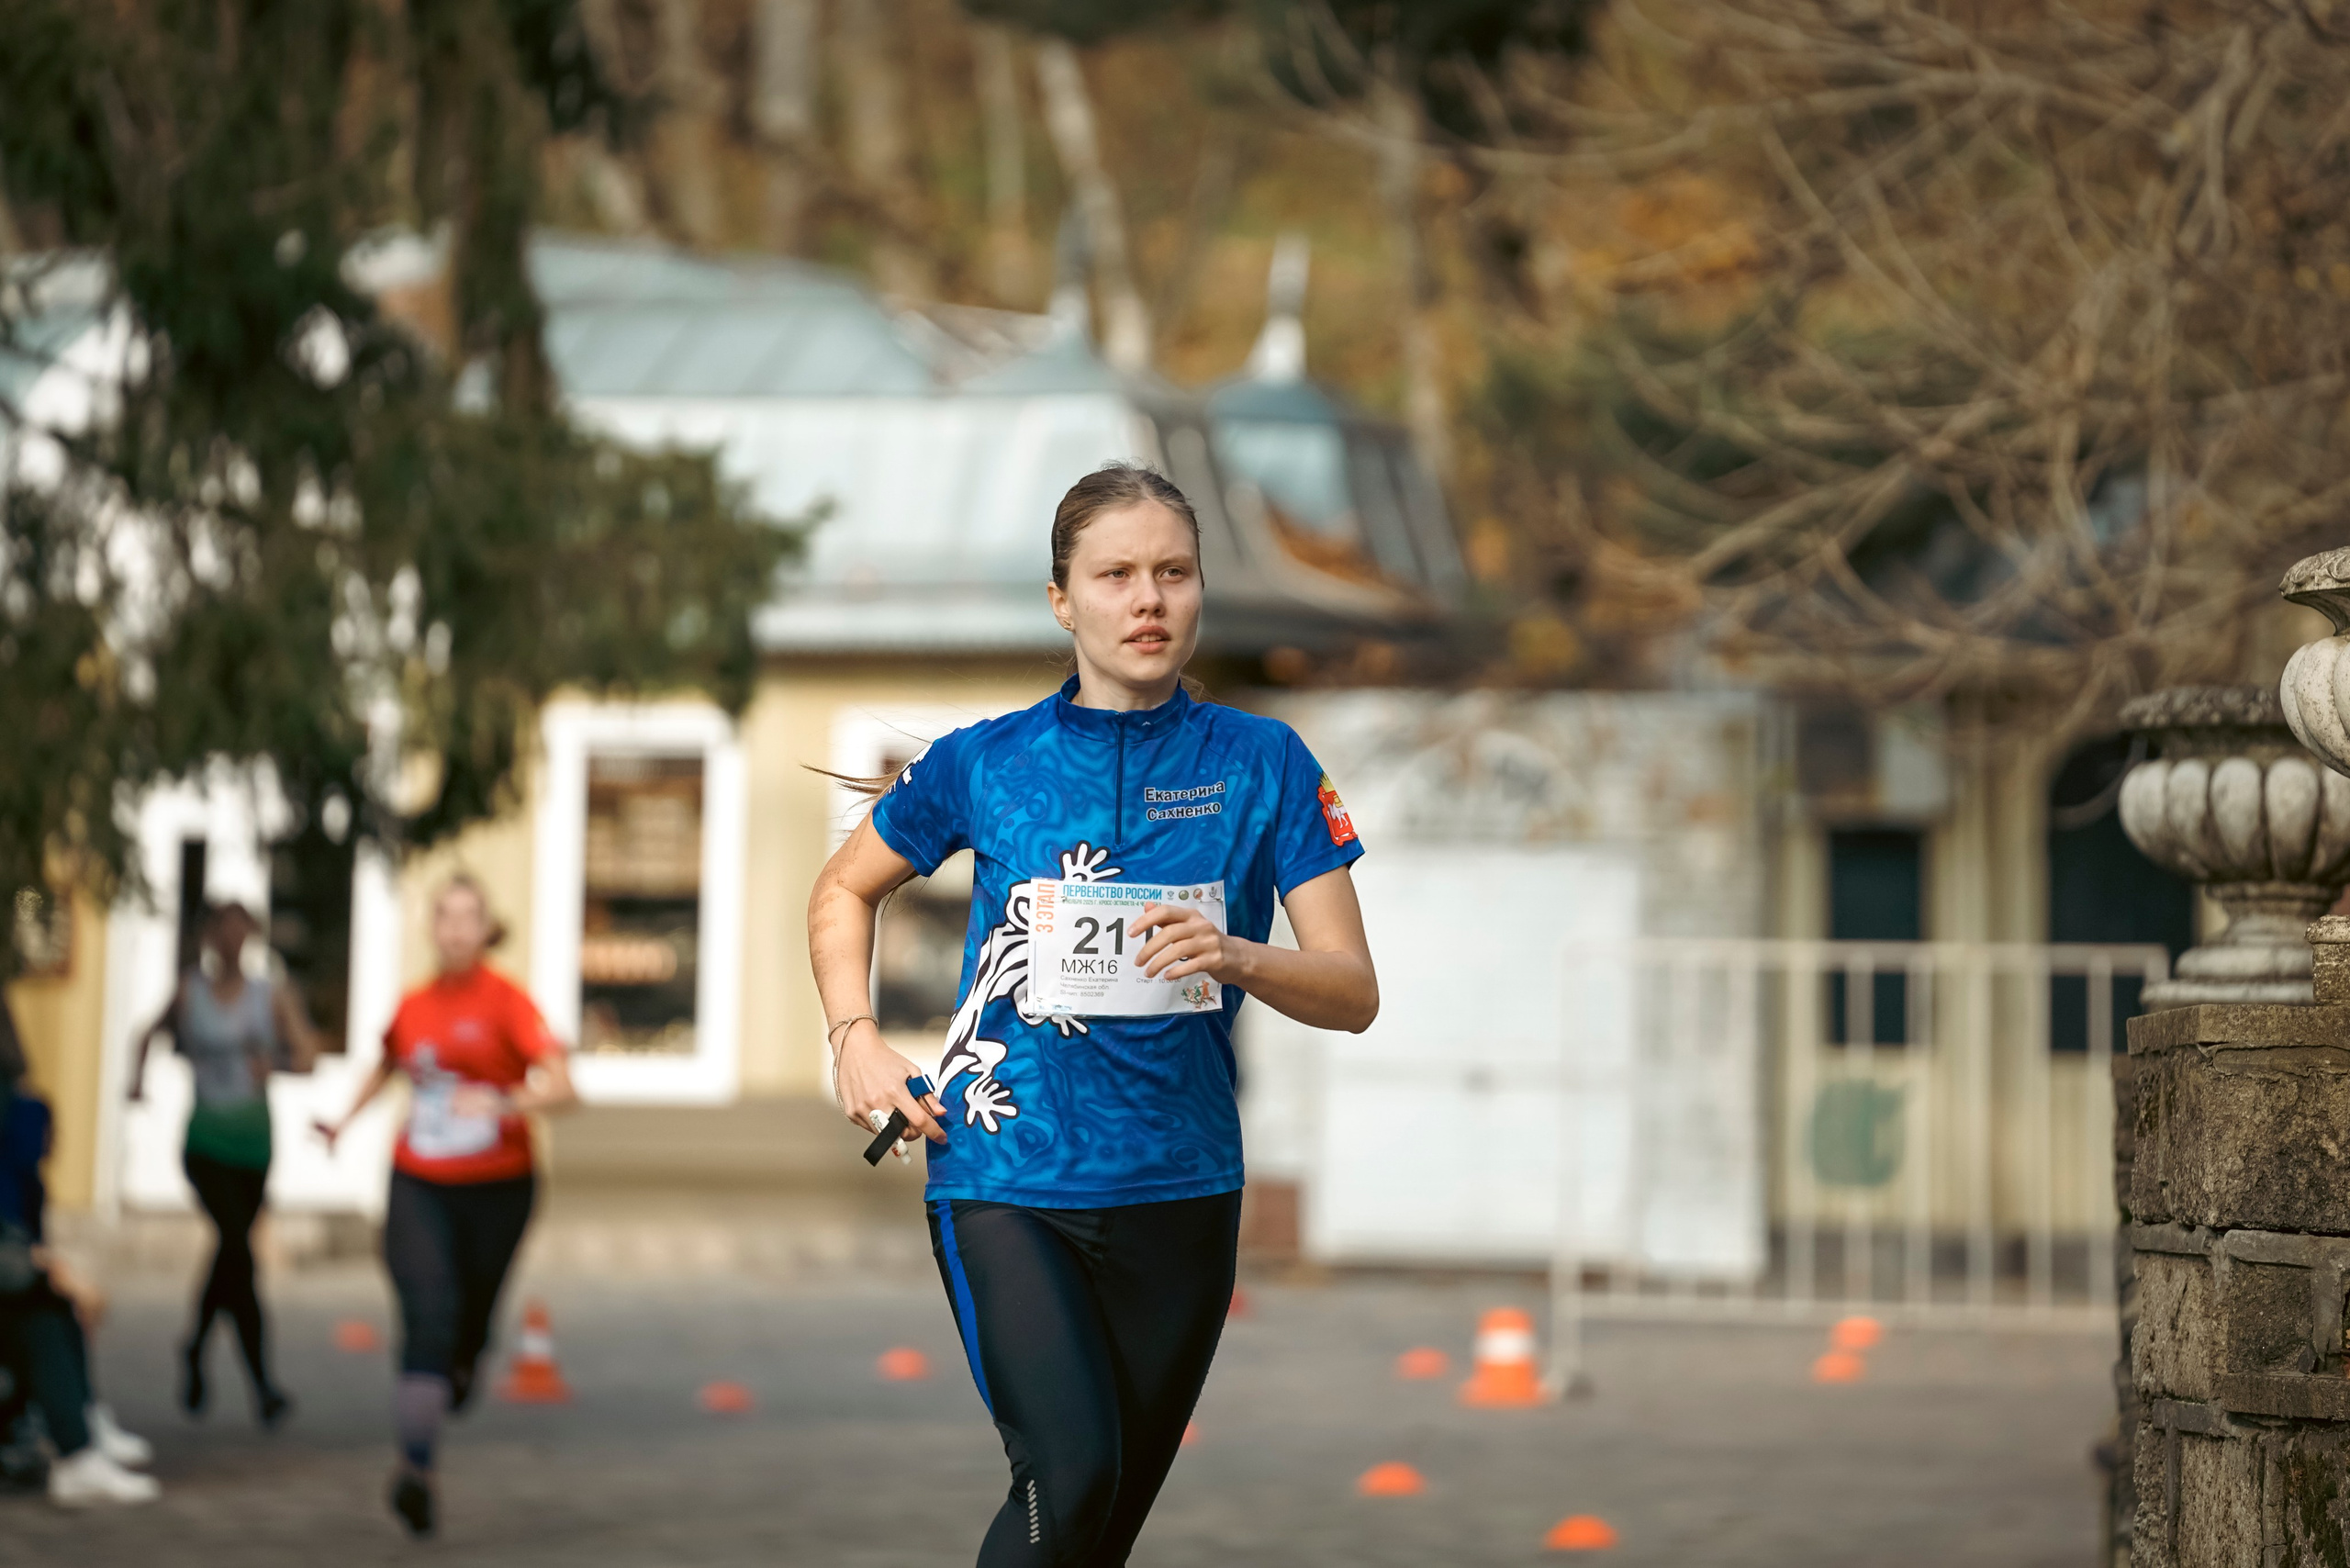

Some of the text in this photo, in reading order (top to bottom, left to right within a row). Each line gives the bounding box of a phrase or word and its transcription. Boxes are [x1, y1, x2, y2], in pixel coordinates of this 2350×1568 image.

[1145, 781, 1225, 802] Екатерина
[1147, 802, 1222, 822] Сахненко
[1036, 883, 1055, 920] ЭТАП
[1063, 884, 1161, 900] ПЕРВЕНСТВО РОССИИ
[1061, 958, 1118, 974] МЖ16
